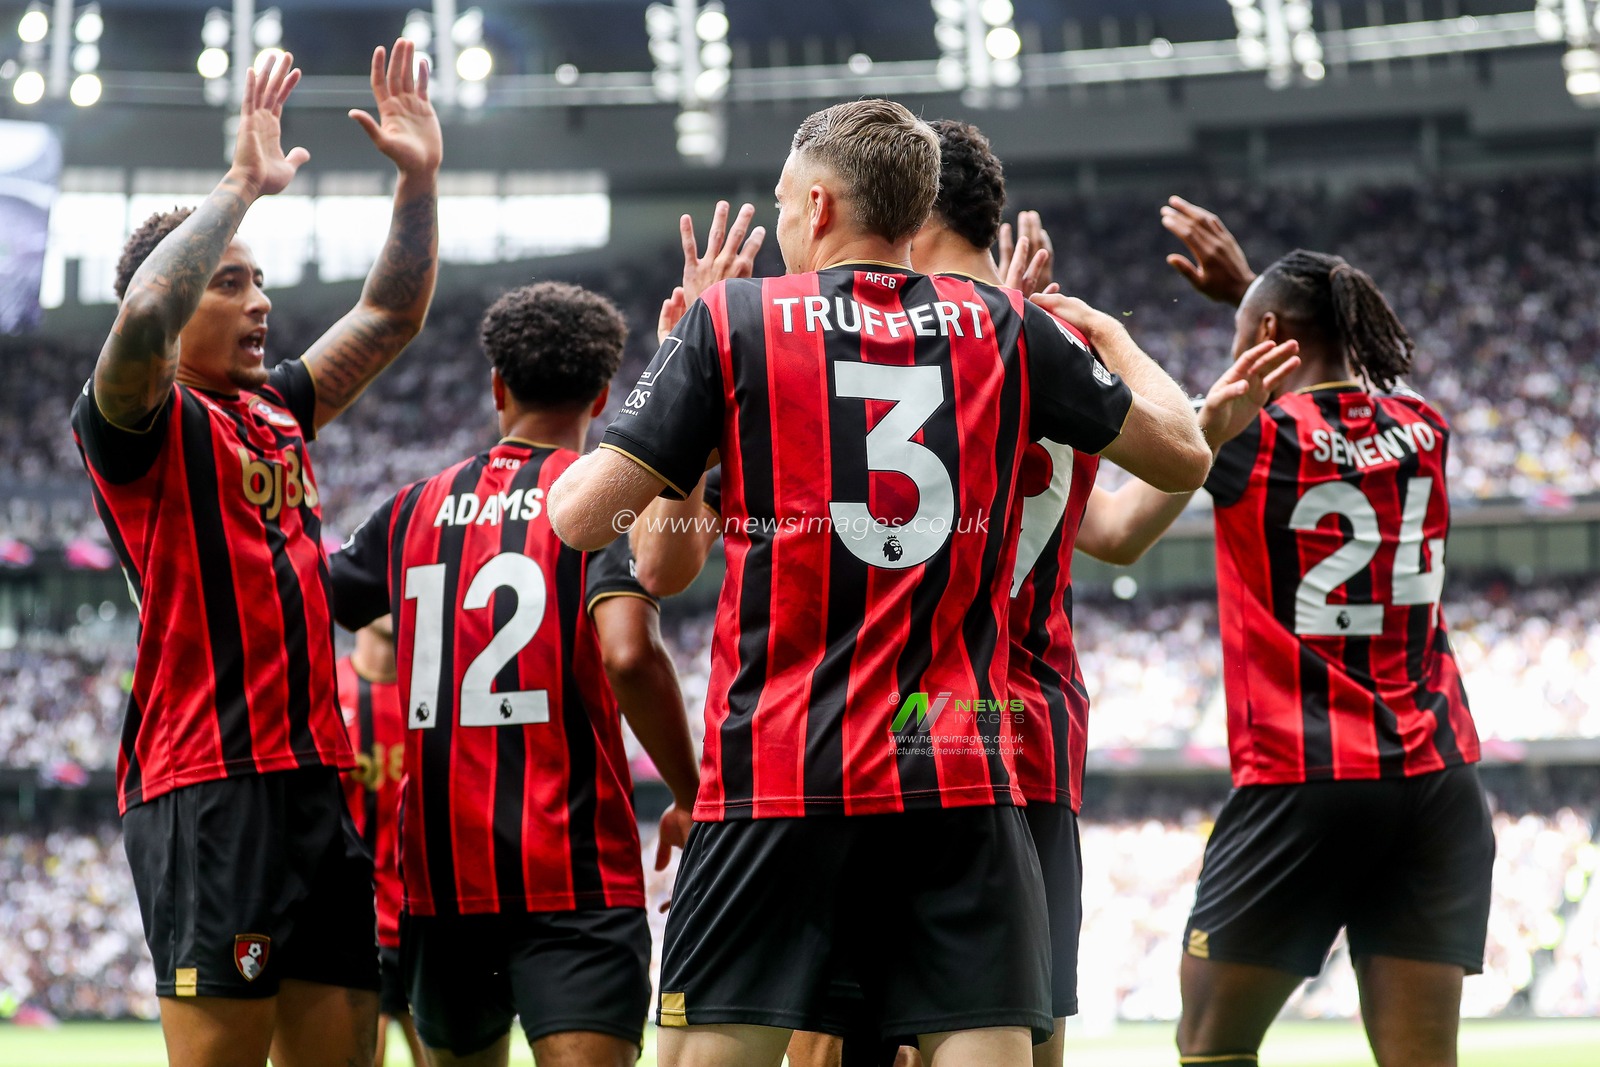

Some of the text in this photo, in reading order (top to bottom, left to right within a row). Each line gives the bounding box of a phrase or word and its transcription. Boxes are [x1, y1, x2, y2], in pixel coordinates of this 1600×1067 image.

[865, 271, 897, 290] AFCB
[773, 295, 984, 339] TRUFFERT
[1347, 405, 1372, 418] AFCB
[491, 457, 521, 471] AFCB
[829, 360, 955, 570] 3
[1311, 421, 1436, 469] SEMENYO
[433, 487, 544, 528] ADAMS
[1289, 477, 1445, 635] 24
[405, 552, 549, 729] 12
